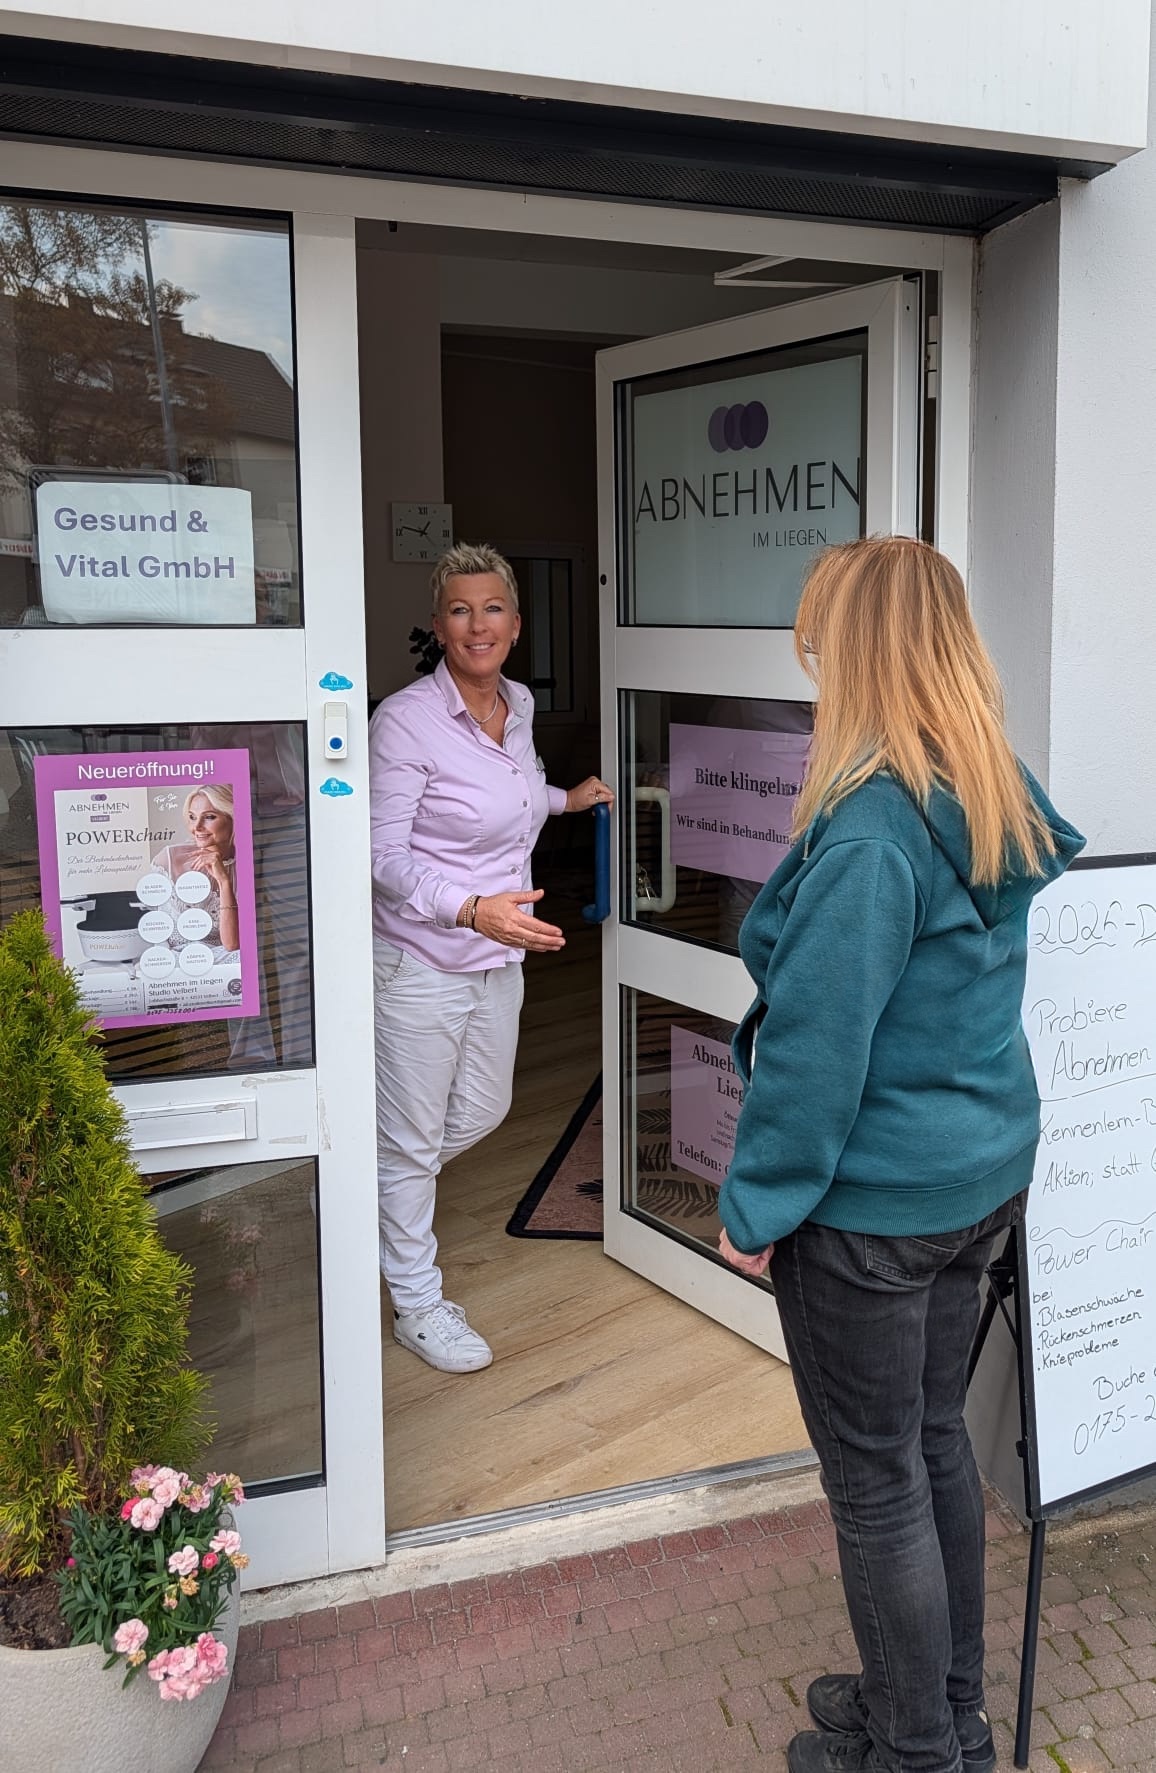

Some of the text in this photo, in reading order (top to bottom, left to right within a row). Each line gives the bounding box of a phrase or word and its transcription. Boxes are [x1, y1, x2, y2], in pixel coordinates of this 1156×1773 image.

[635, 456, 860, 523] ABNEHMEN
[54, 507, 208, 533] Gesund &
[753, 527, 827, 548] IM LIEGEN
[55, 554, 235, 579] Vital GmbH
[78, 759, 215, 780] Neueröffnung!!
[694, 767, 728, 788] Bitte
[69, 802, 130, 812] ABNEHMEN
[66, 828, 176, 846] POWERchair
[676, 814, 695, 829] Wir
[696, 818, 718, 833] sind
[719, 821, 730, 835] in
[1029, 997, 1128, 1037] Probiere
[691, 1043, 739, 1074] Abneh
[1051, 1040, 1151, 1091] Abnehmen
[717, 1076, 744, 1106] Lieg
[677, 1140, 722, 1172] Telefon:
[1102, 1151, 1143, 1178] statt
[1034, 1227, 1153, 1275] Power Chair
[1033, 1286, 1053, 1304] bei
[1093, 1365, 1146, 1400] Buche
